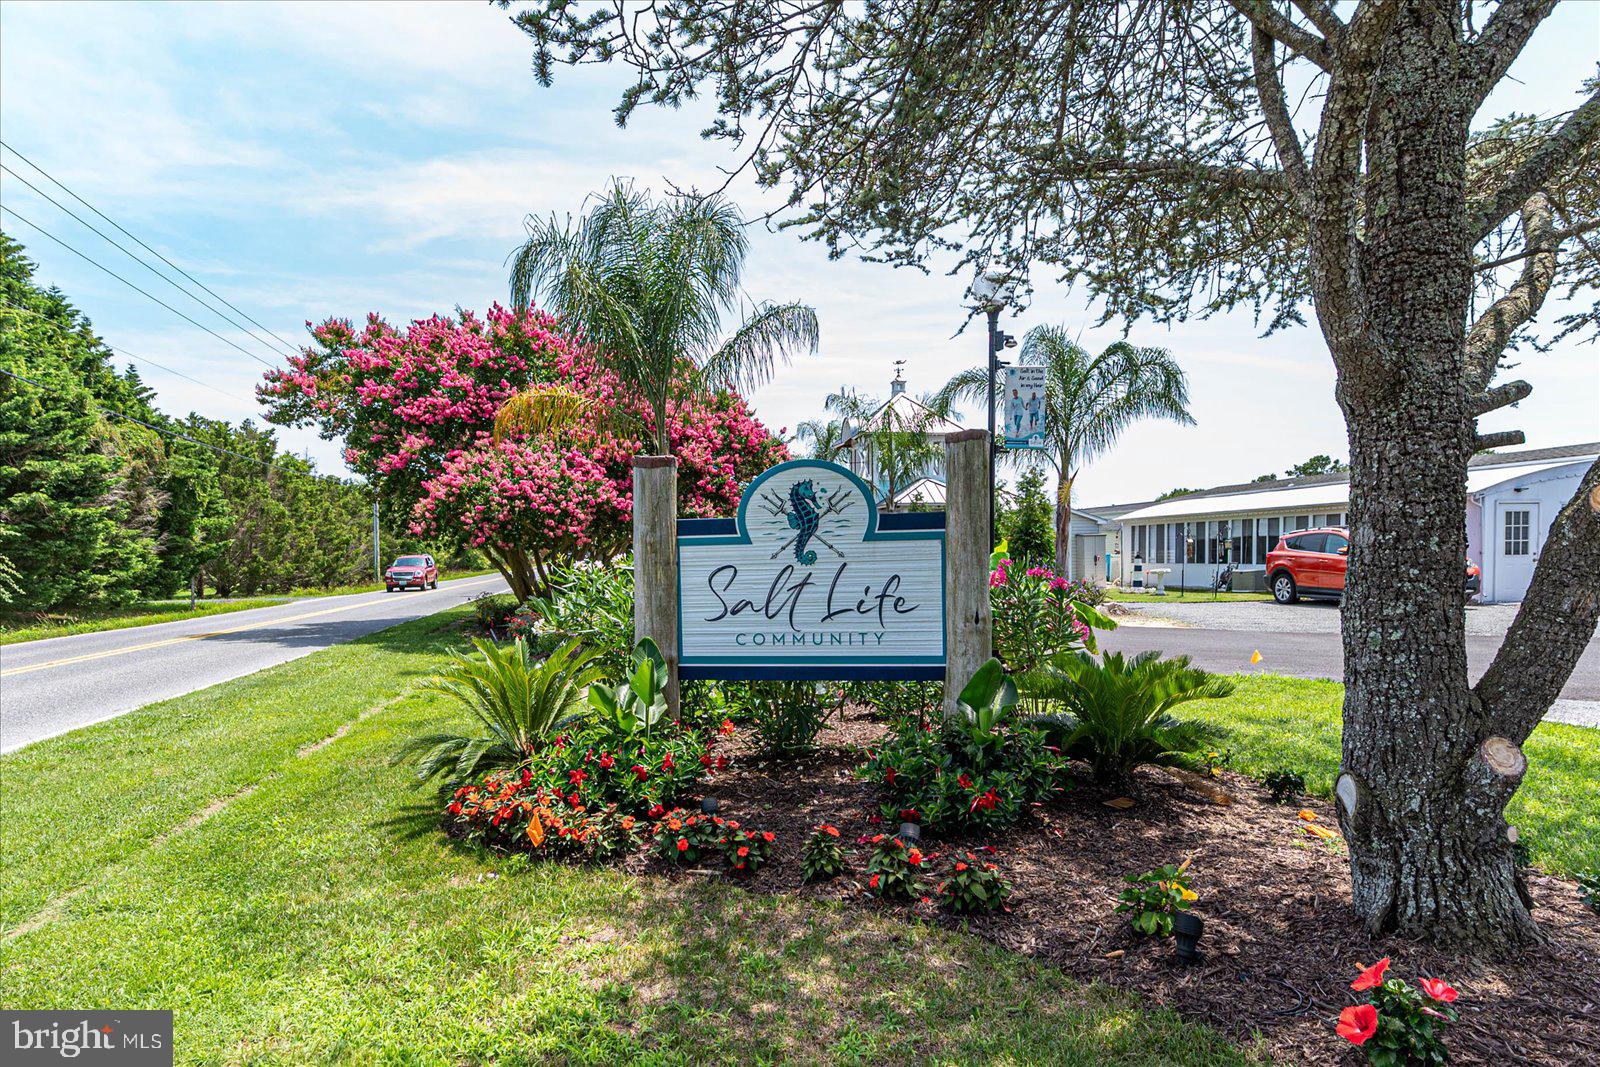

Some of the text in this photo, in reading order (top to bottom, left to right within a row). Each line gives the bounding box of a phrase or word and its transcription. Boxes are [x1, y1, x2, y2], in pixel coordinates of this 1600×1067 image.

[704, 562, 920, 632] Salt Life
[735, 632, 886, 646] COMMUNITY
